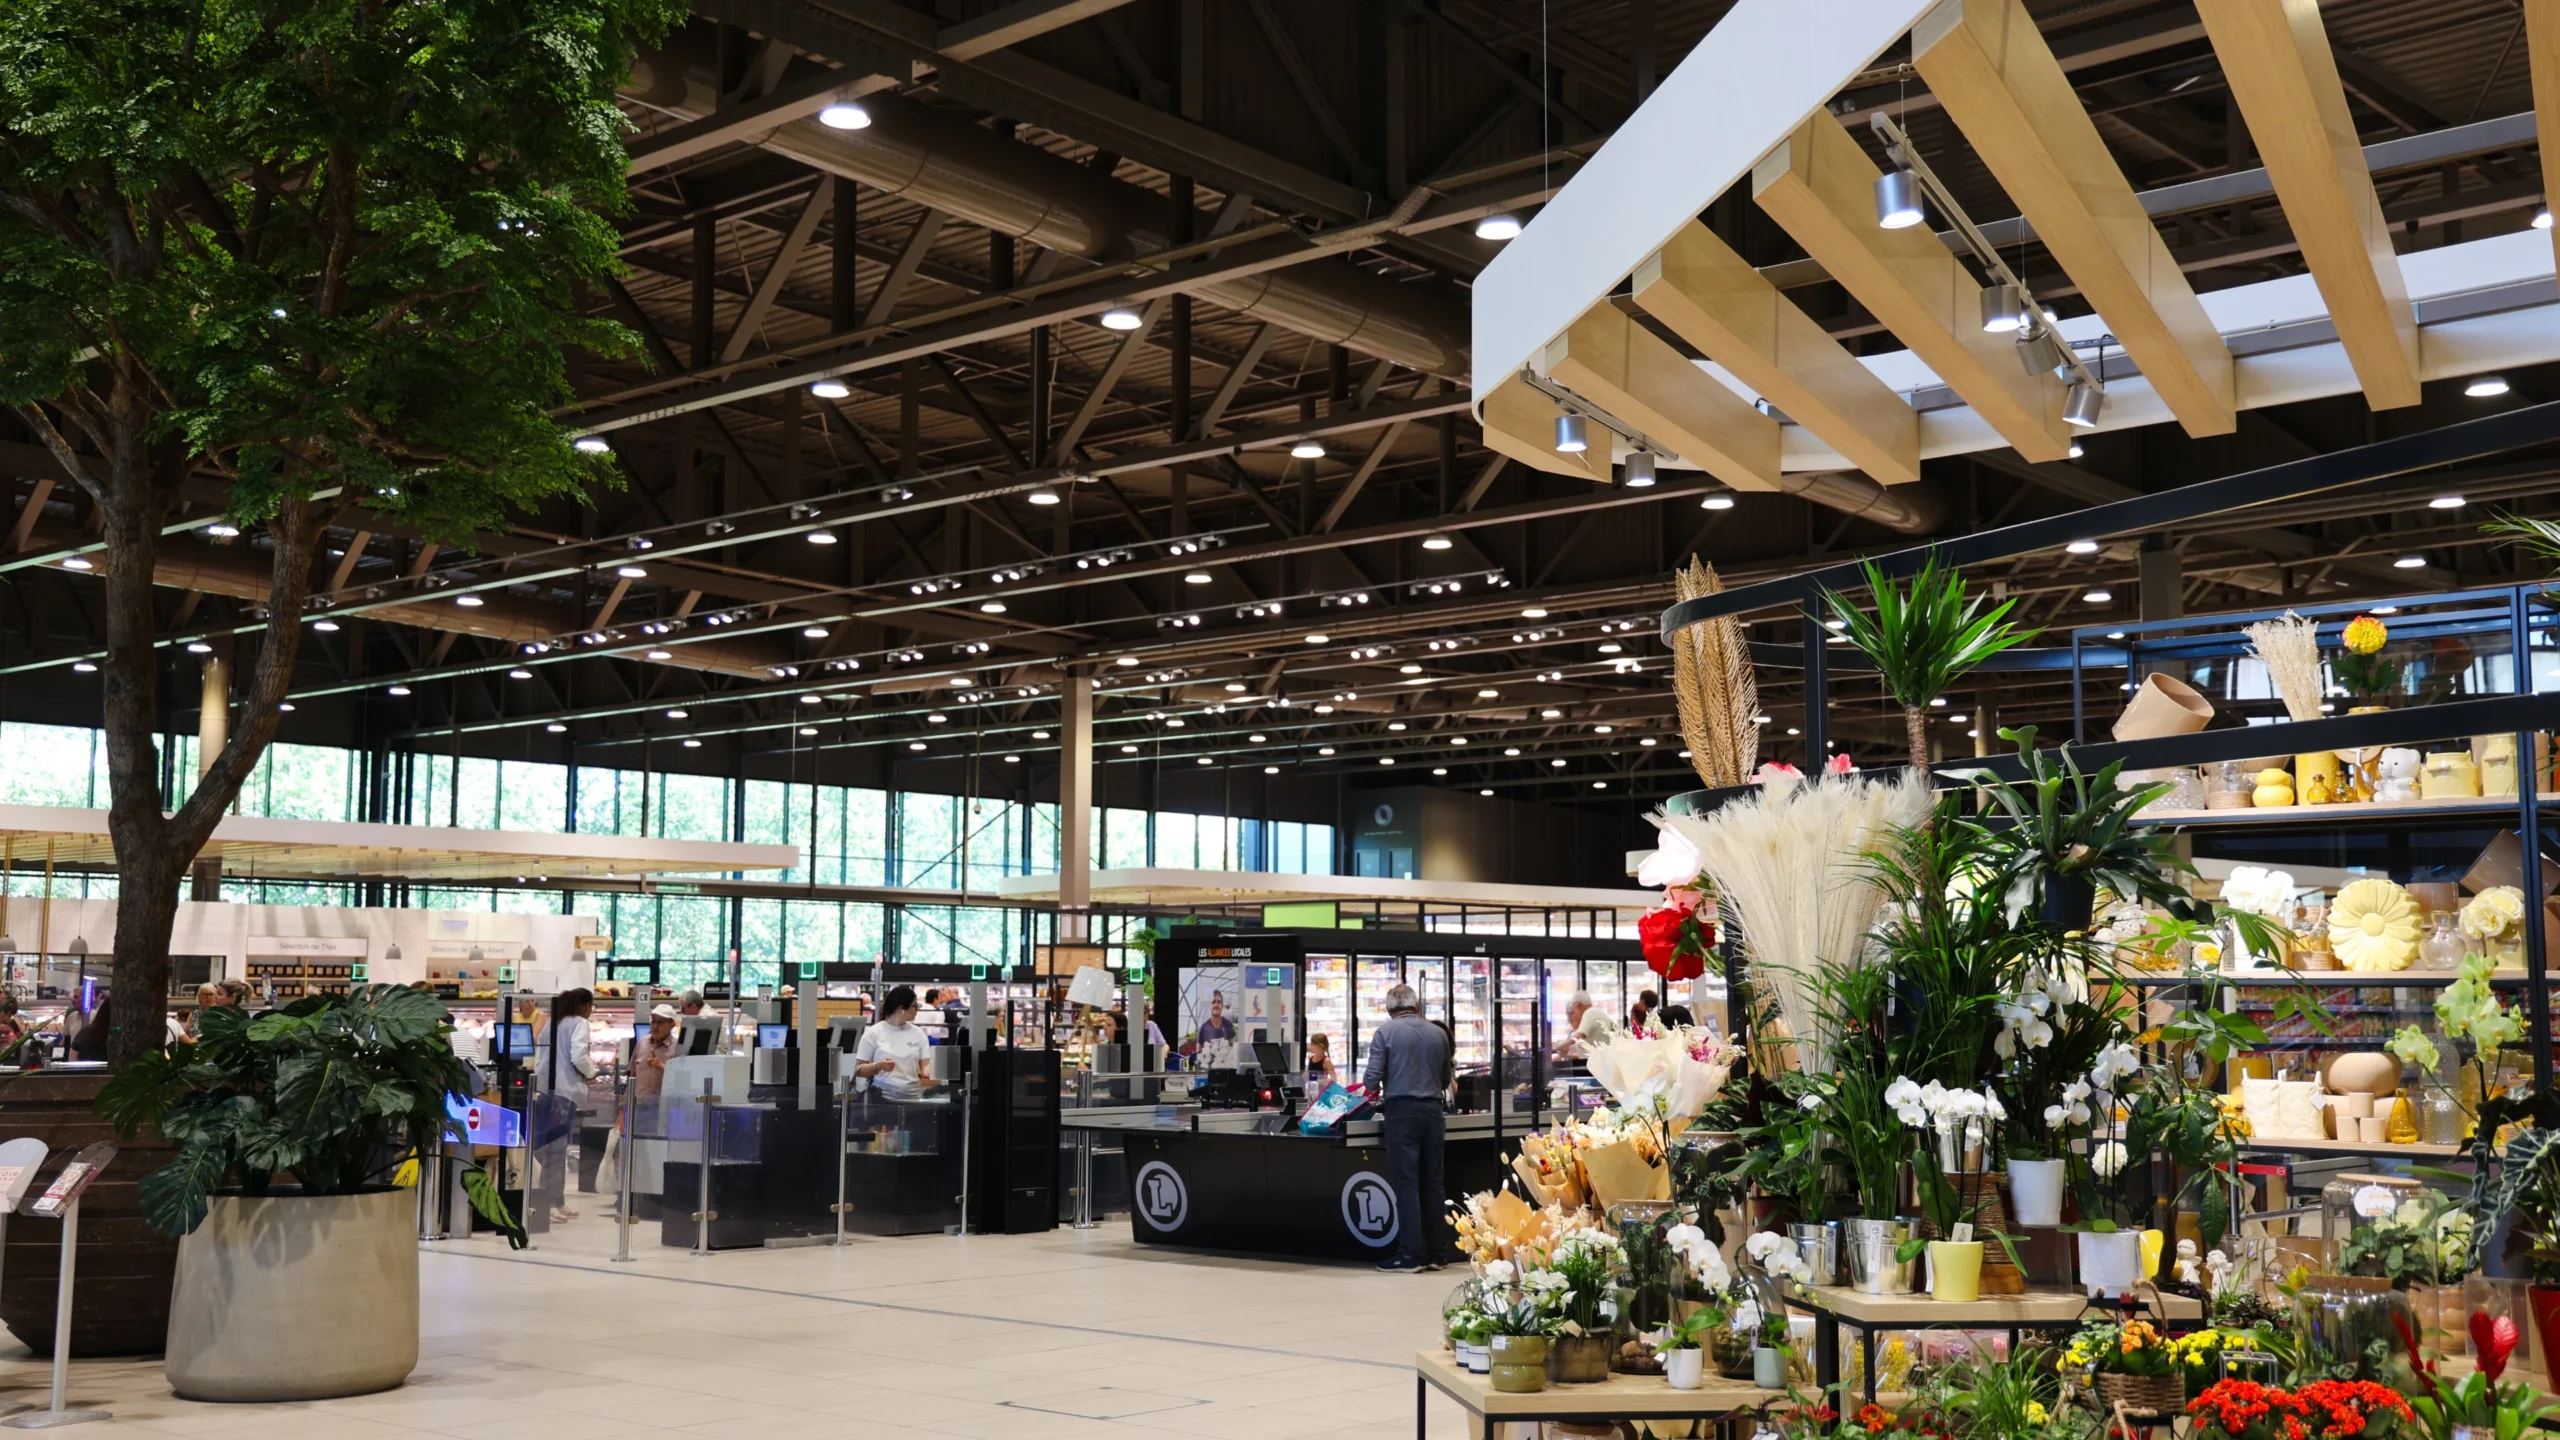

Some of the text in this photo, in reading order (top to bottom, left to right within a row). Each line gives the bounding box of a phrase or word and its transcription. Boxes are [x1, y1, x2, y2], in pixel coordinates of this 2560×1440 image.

[1198, 948, 1251, 957] LES ALLIANCES LOCALES
[639, 993, 648, 1002] CB
[762, 994, 770, 1002] CB
